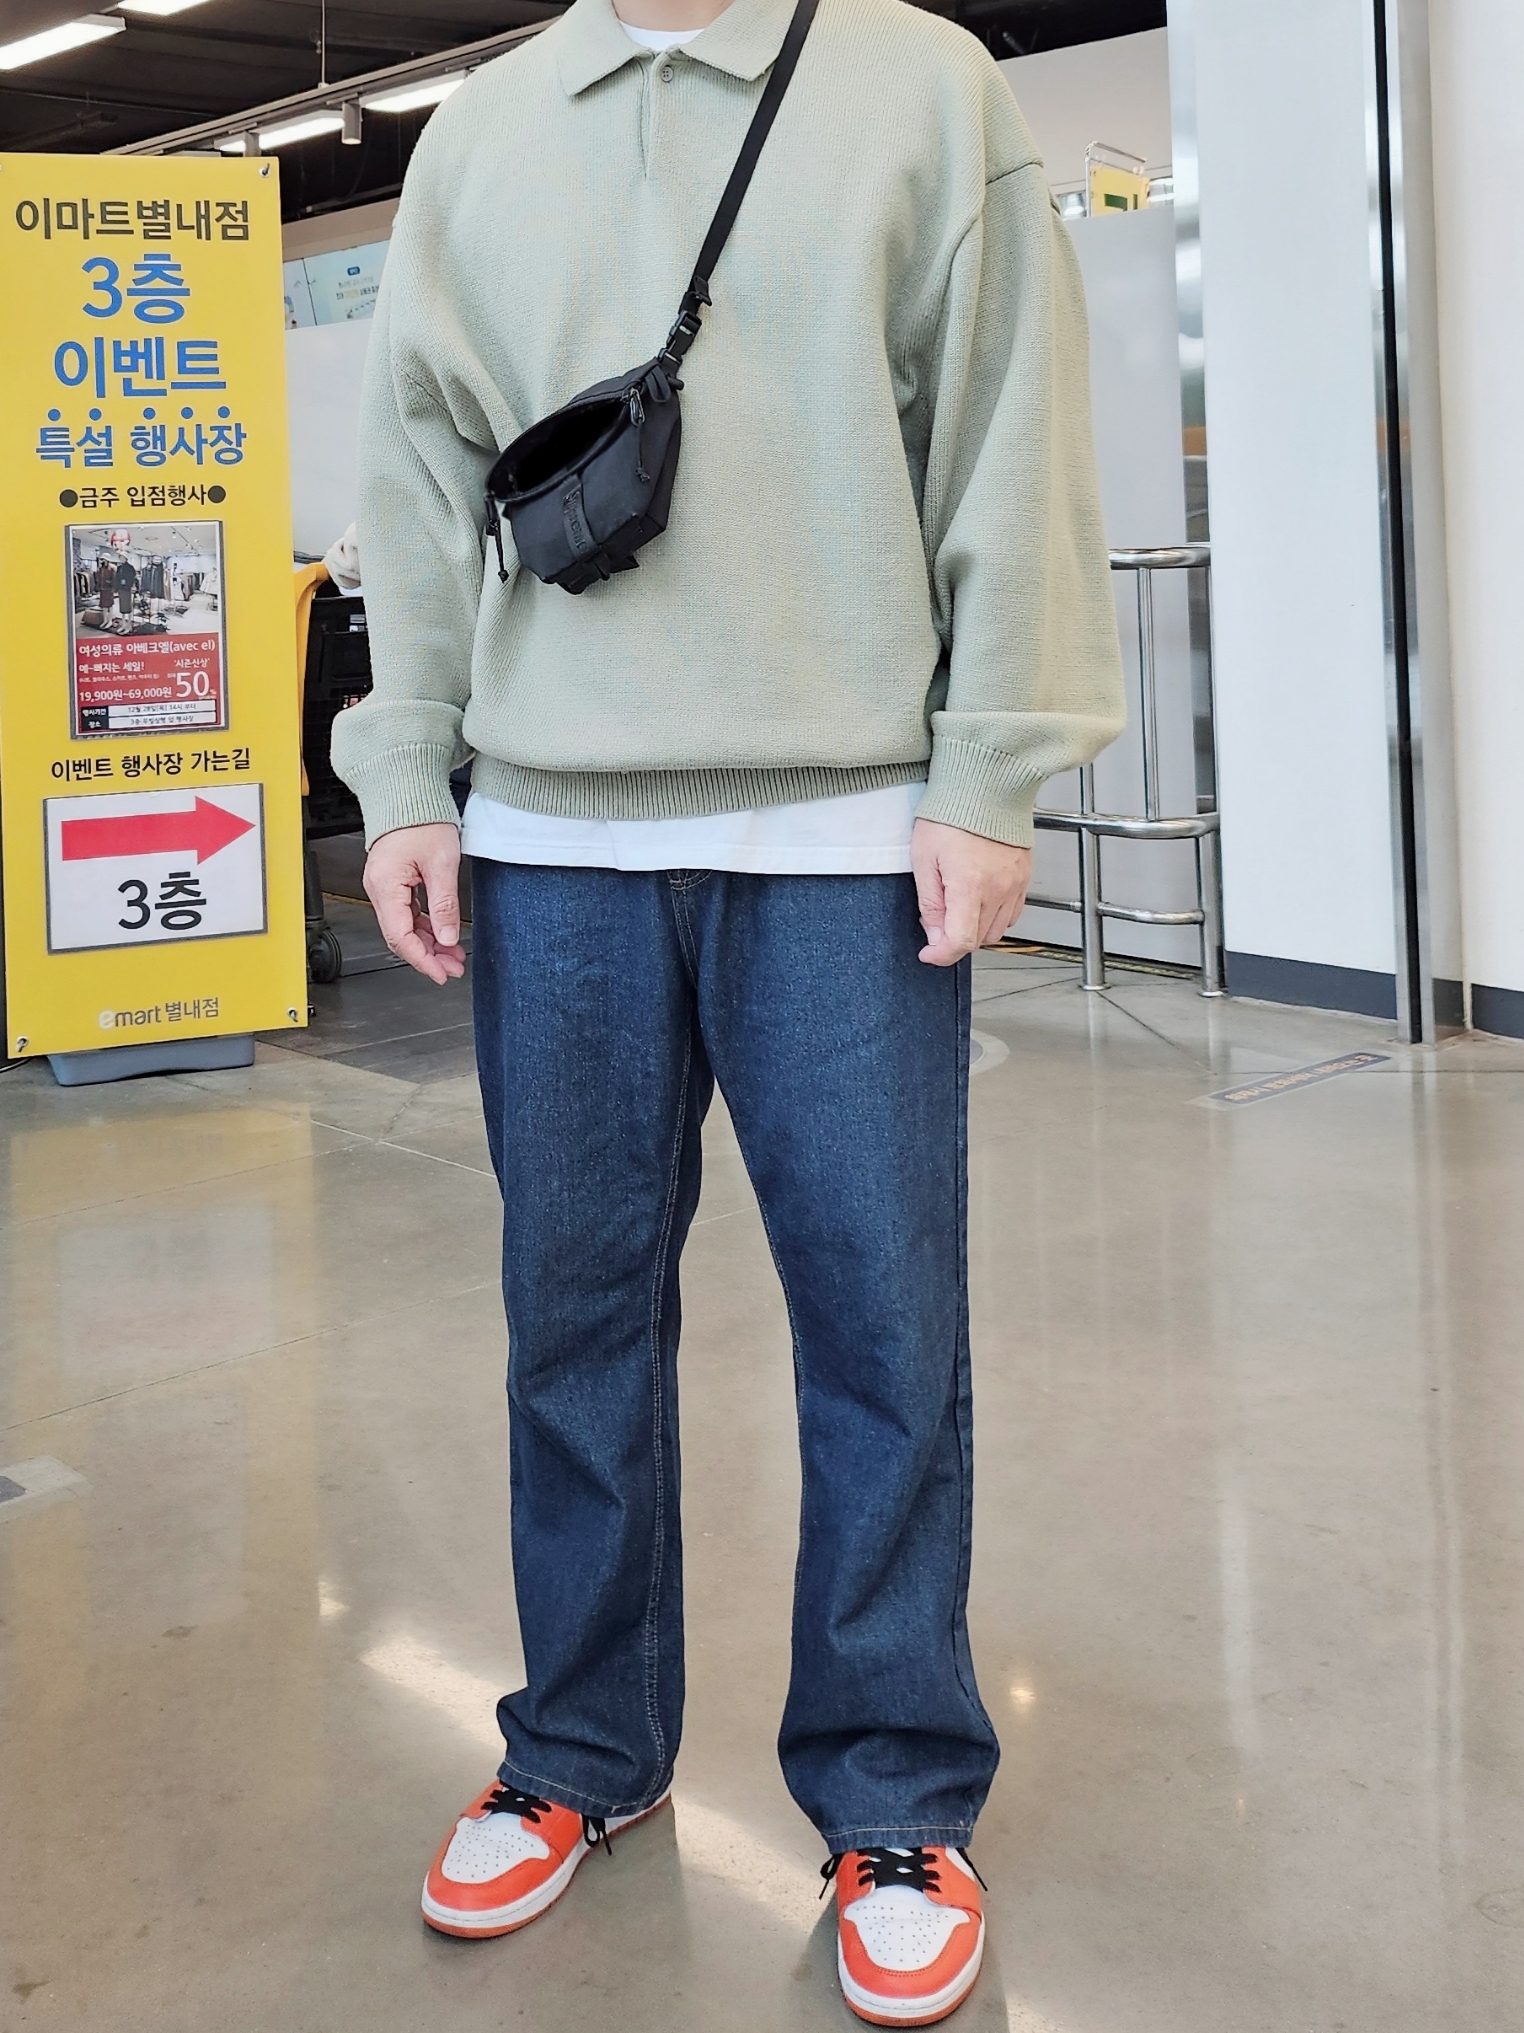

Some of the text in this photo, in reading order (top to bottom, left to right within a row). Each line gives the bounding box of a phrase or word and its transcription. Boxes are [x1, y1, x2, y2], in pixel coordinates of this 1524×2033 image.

[15, 197, 249, 241] 이마트별내점
[81, 253, 191, 324] 3층
[54, 336, 227, 399] 이벤트
[36, 422, 248, 468] 특설 행사장
[79, 484, 207, 509] 금주 입점행사
[79, 644, 123, 658] 여성의류
[51, 747, 251, 782] 이벤트 행사장 가는길
[117, 871, 207, 931] 3층
[99, 997, 219, 1029] emart 별내점
